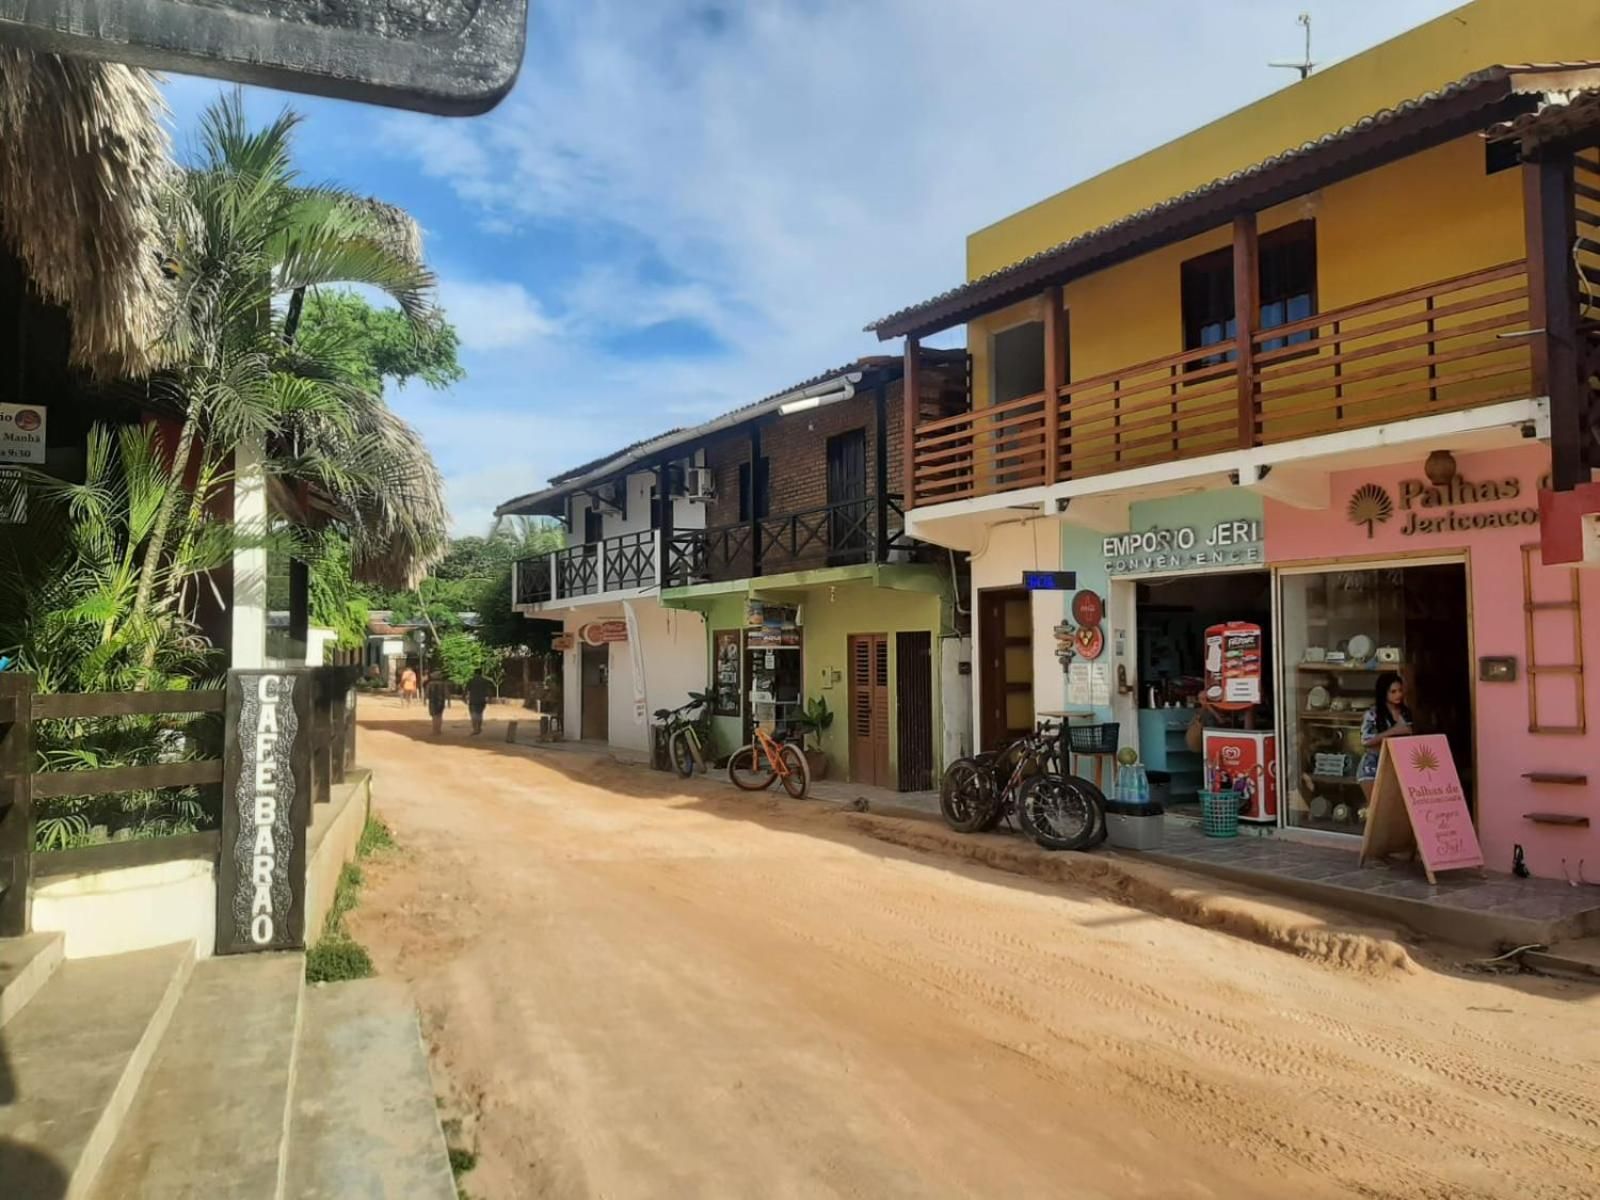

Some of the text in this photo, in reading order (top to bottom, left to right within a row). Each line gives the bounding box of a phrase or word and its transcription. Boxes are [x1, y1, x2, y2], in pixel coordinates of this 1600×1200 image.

[1399, 472, 1520, 510] Palhas
[1206, 521, 1257, 545] JERI
[1401, 507, 1540, 536] Jericoaco
